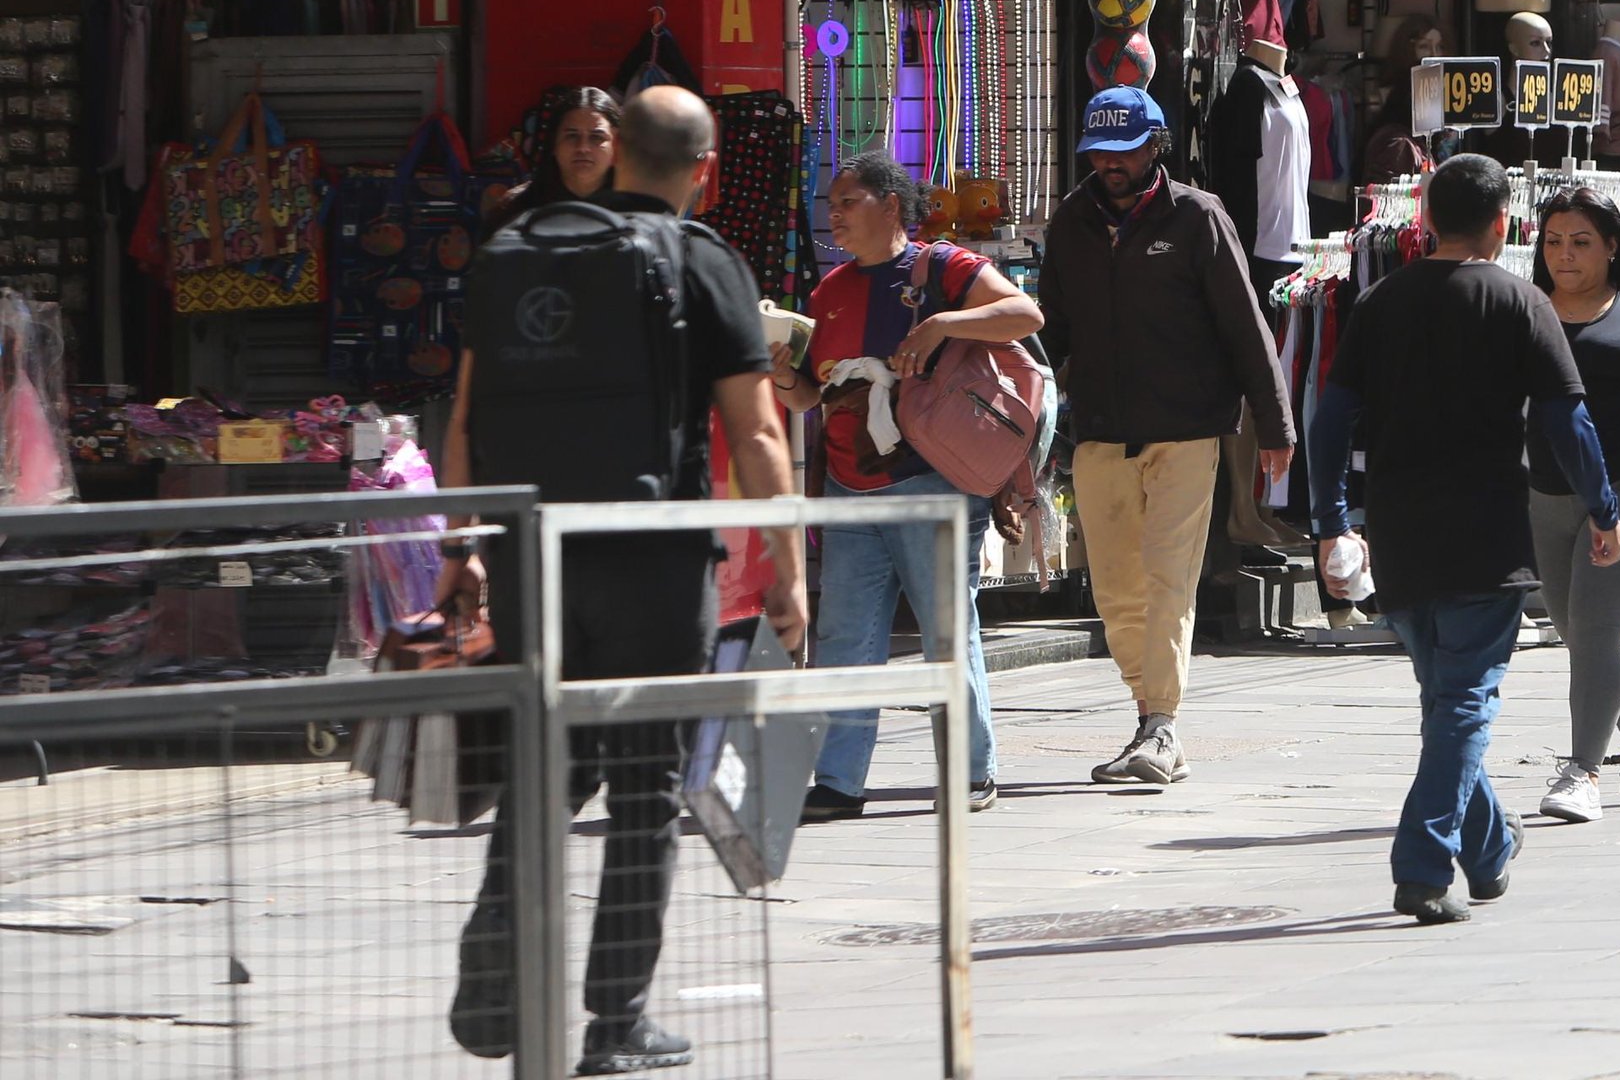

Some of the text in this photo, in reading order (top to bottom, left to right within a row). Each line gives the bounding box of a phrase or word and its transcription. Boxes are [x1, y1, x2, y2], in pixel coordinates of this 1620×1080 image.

[1443, 72, 1493, 113] 19,99
[1523, 74, 1547, 114] 19,99
[1562, 72, 1593, 112] 19,99
